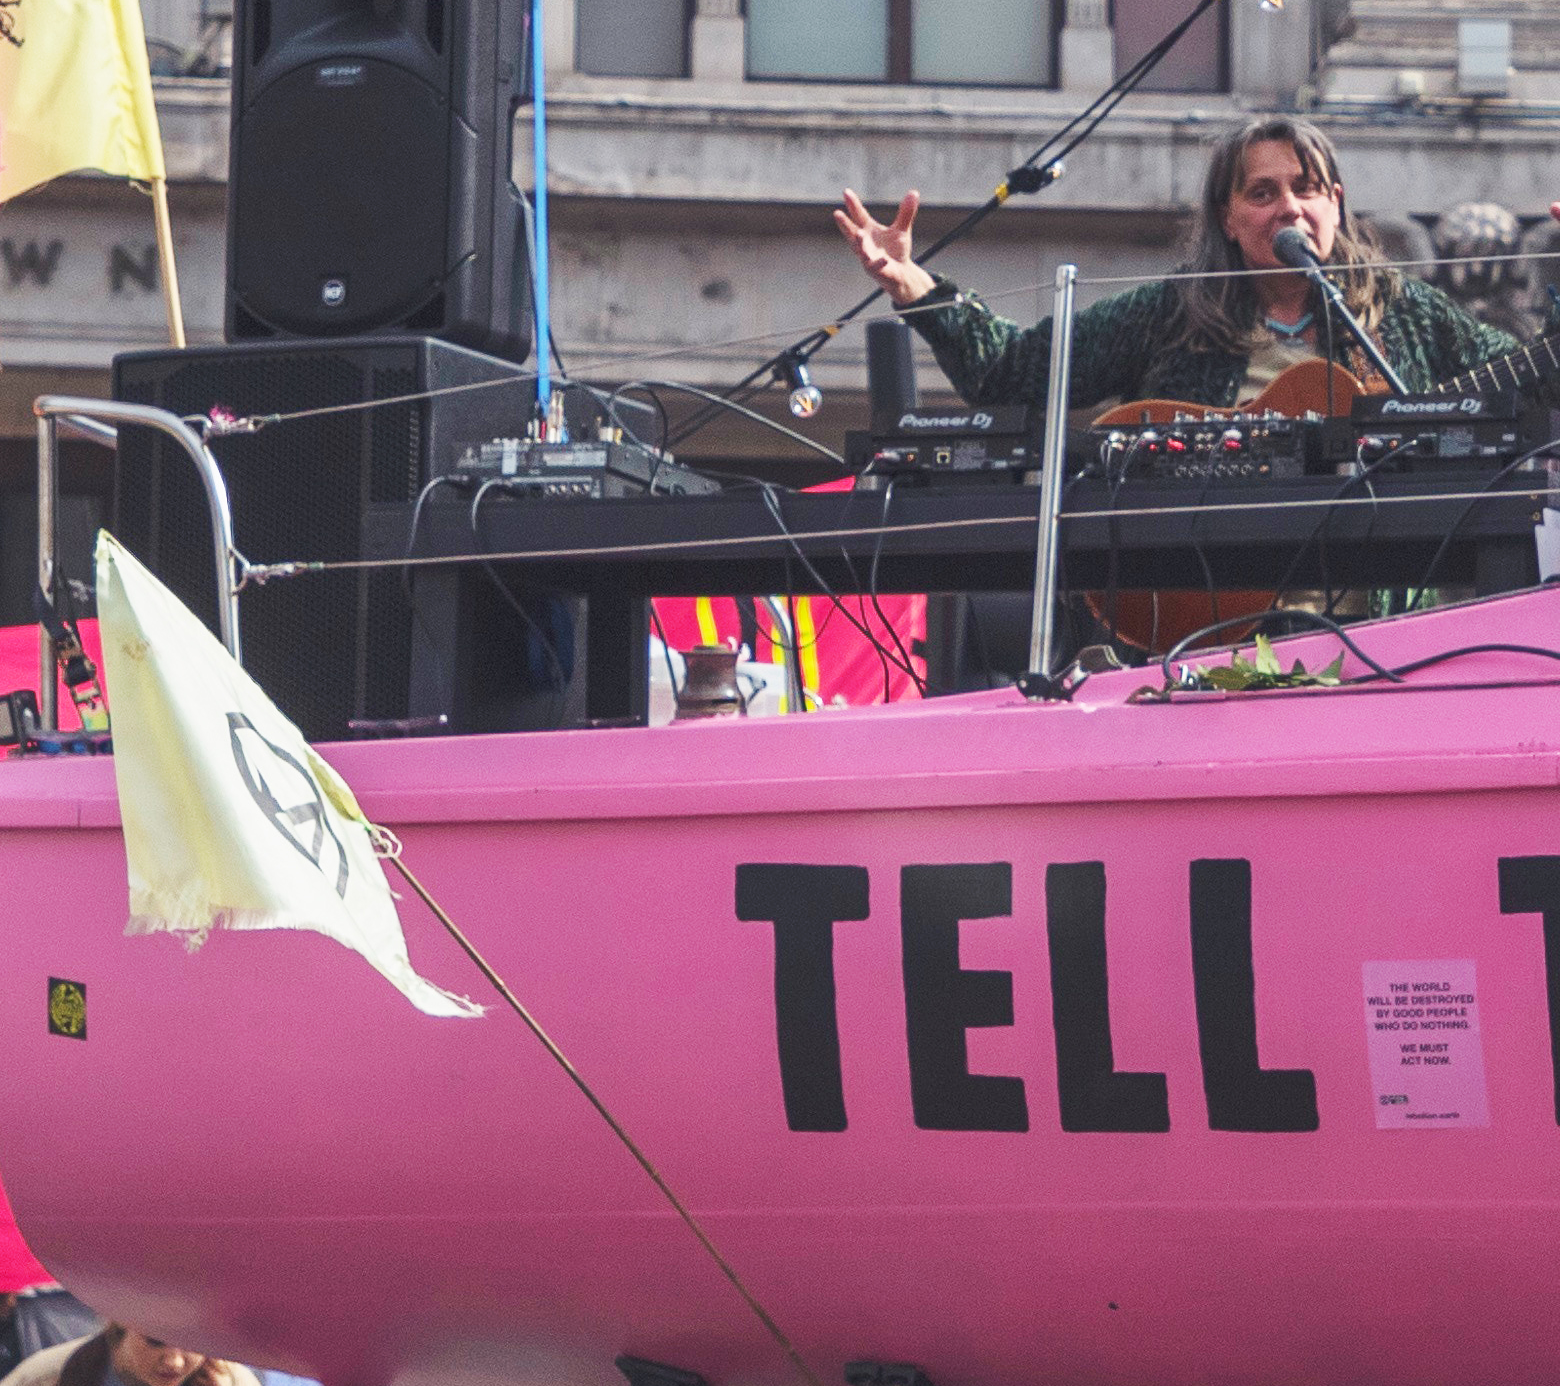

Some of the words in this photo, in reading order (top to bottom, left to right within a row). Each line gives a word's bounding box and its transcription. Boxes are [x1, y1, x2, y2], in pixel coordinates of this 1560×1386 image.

[1381, 399, 1458, 414] Pioneer
[898, 413, 969, 428] Pioneer
[1390, 982, 1408, 992] THE
[1412, 982, 1450, 992] WORLD
[736, 859, 1319, 1132] TELL
[1367, 996, 1391, 1006] WILL
[1395, 996, 1408, 1005] BE
[1411, 994, 1474, 1006] DESTROYED
[1376, 1009, 1390, 1018] BY
[1393, 1008, 1424, 1018] GOOD
[1427, 1007, 1467, 1017] PEOPLE
[1374, 1021, 1400, 1031] WHO
[1403, 1021, 1418, 1030] DO
[1400, 1044, 1417, 1053] WE
[1420, 1043, 1448, 1053] MUST
[1401, 1056, 1421, 1066] ACT
